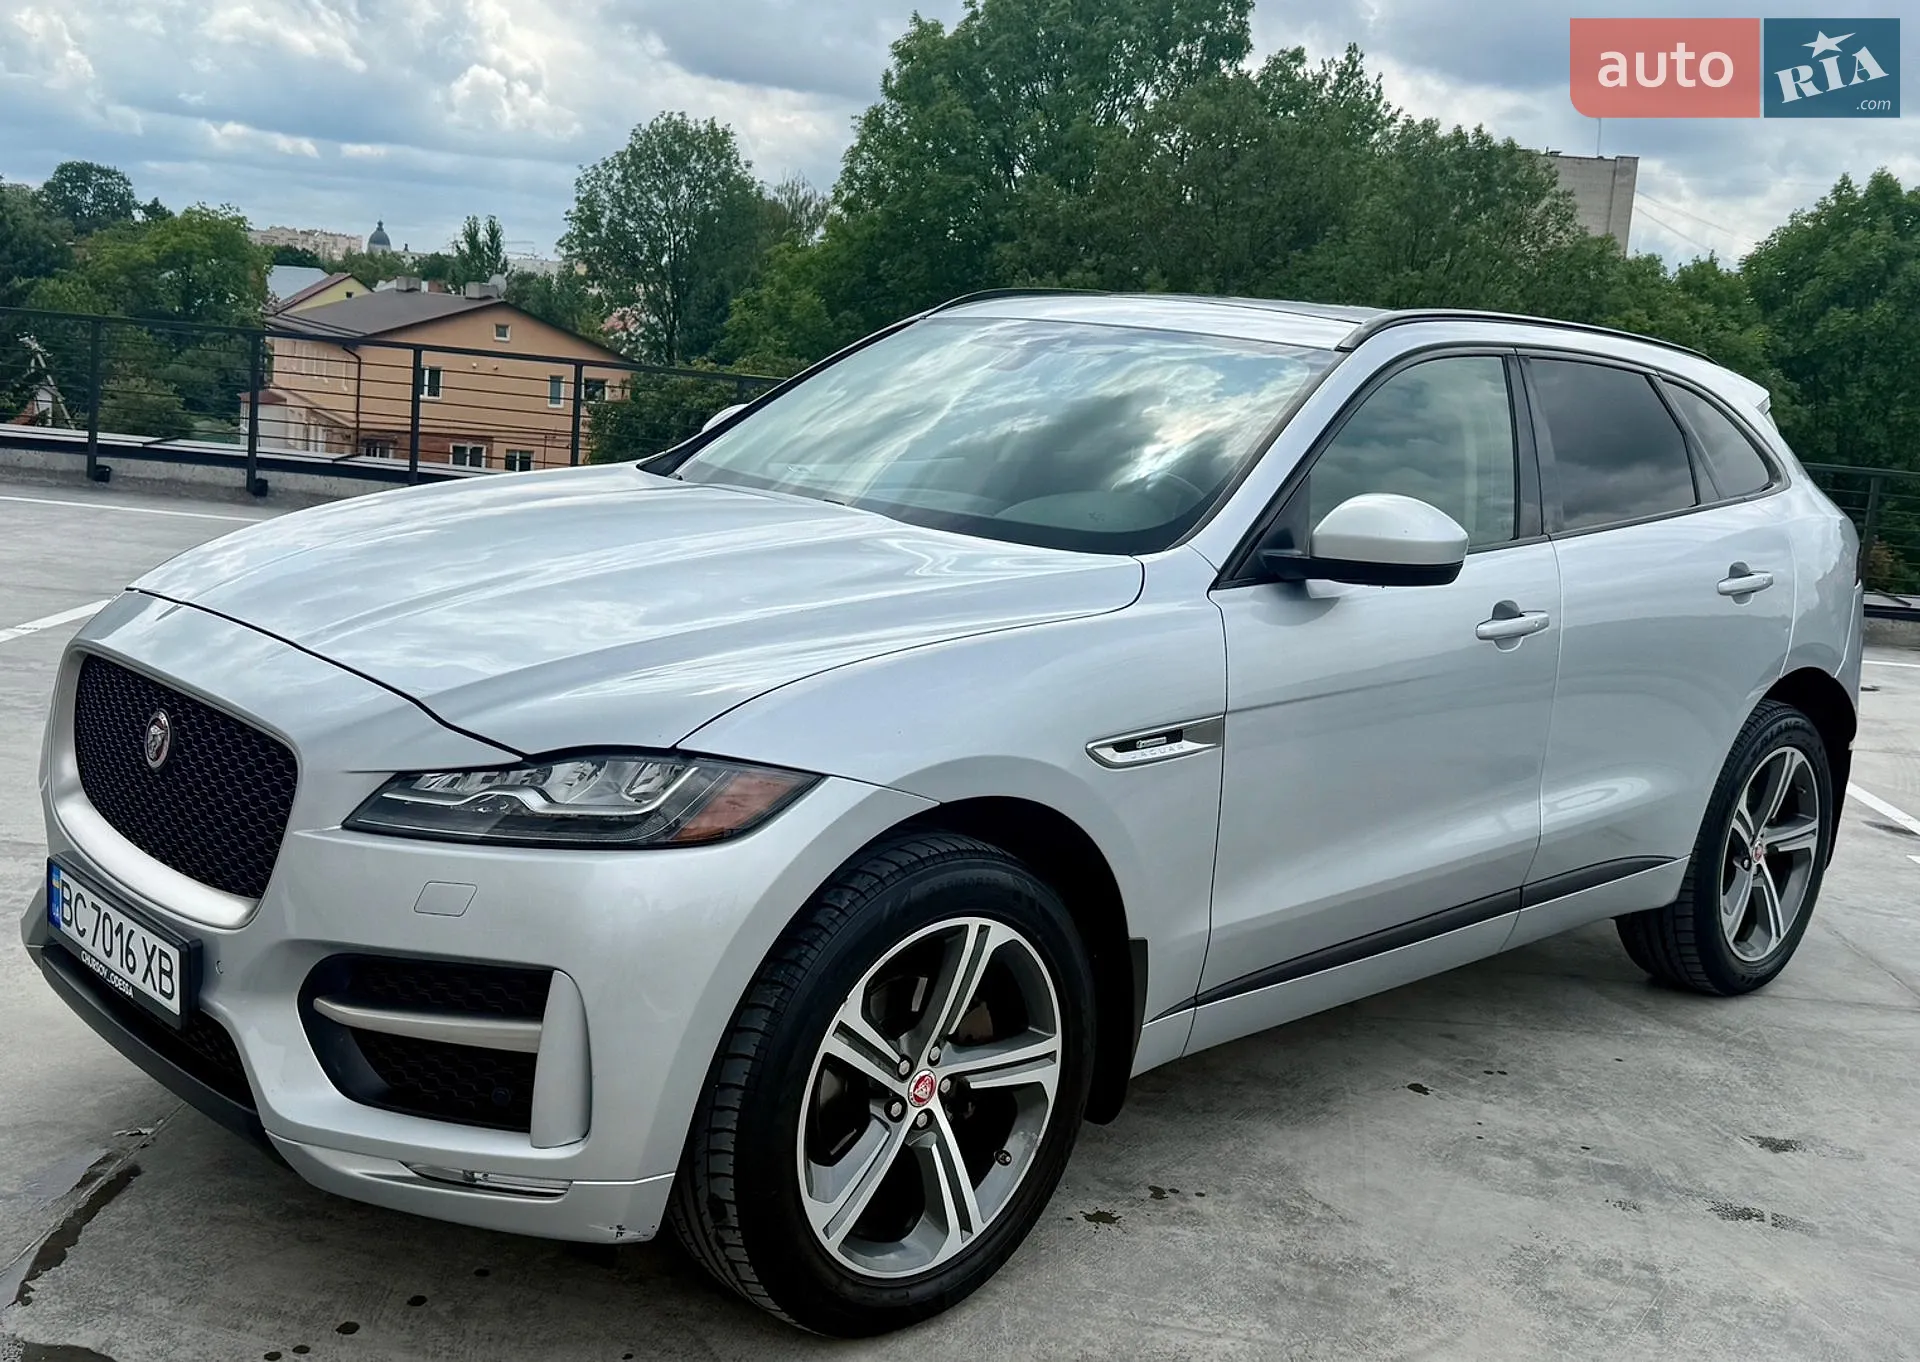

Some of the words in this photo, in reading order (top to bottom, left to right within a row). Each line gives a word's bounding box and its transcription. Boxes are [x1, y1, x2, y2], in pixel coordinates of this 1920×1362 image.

[61, 880, 86, 938] BC
[91, 902, 136, 975] 7016
[142, 936, 175, 1001] XB
